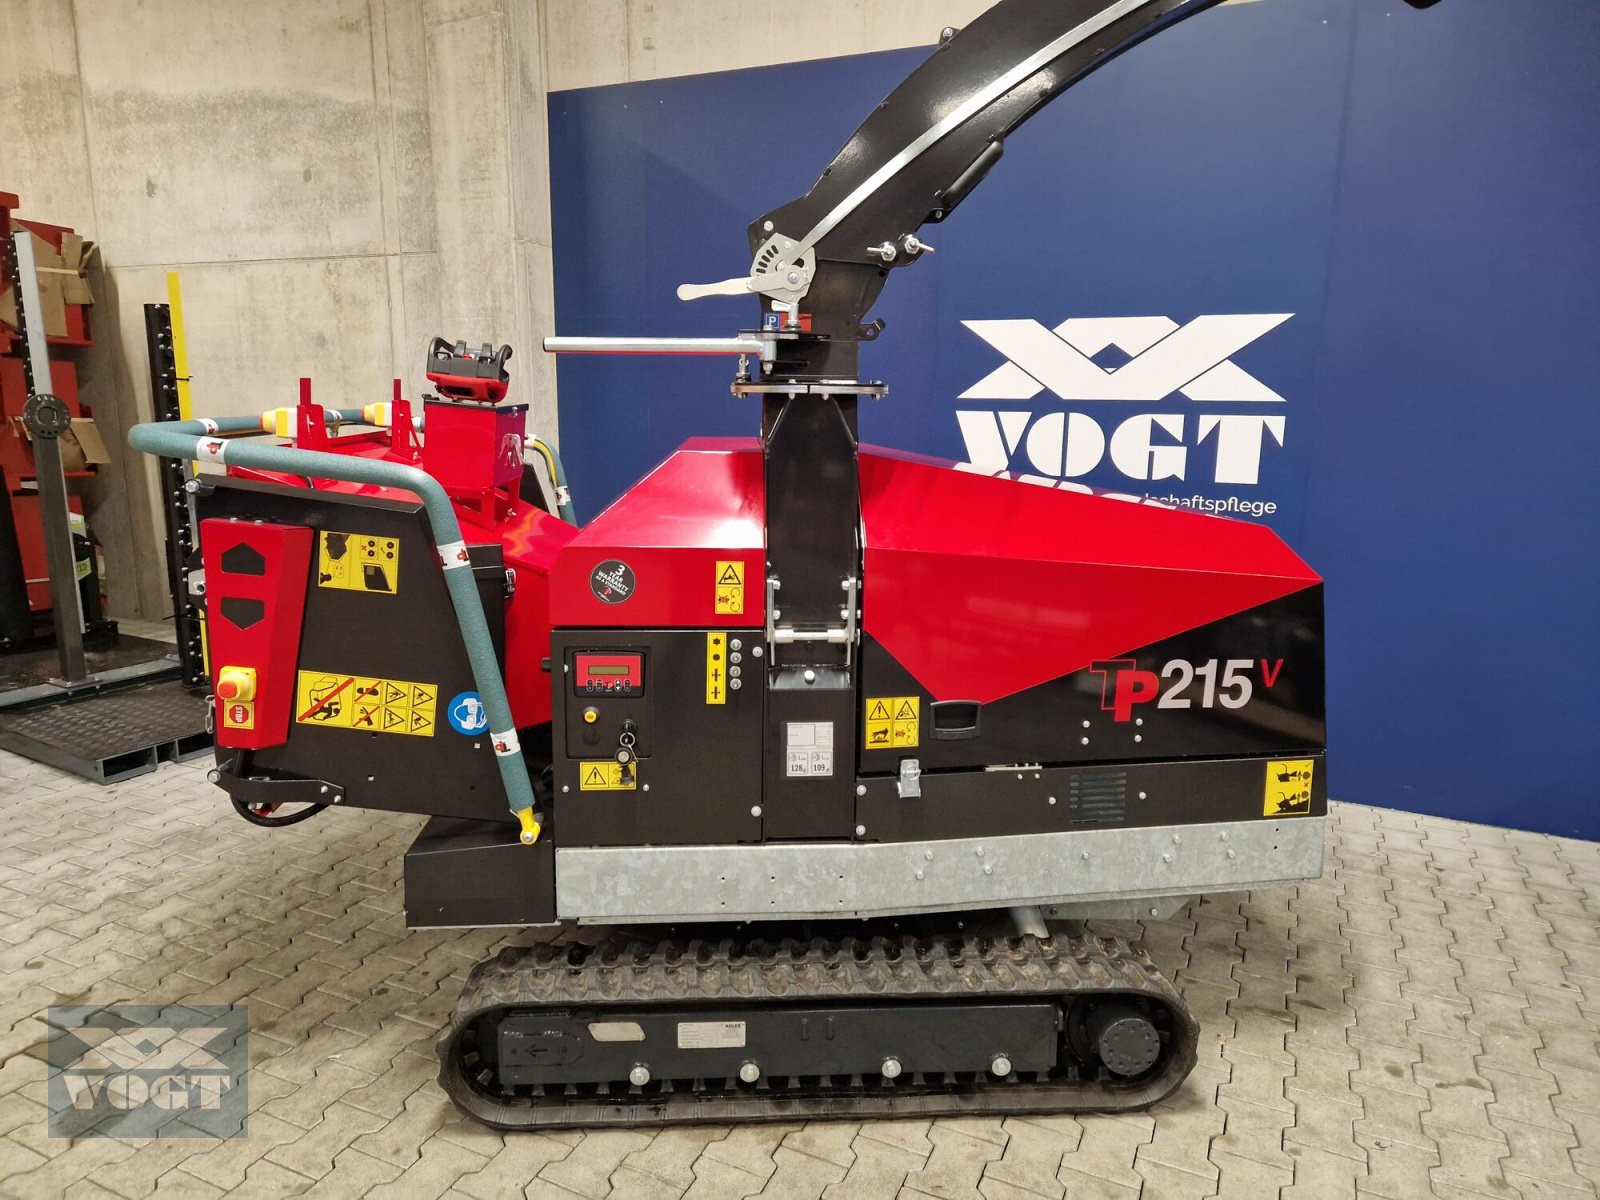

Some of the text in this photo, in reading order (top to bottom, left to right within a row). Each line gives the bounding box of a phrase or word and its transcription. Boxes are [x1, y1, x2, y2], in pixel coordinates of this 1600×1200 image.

[769, 316, 777, 326] P
[956, 410, 1286, 484] VOGT
[615, 564, 626, 576] 3
[598, 570, 629, 592] WARRANTY
[609, 571, 624, 584] YEAR
[1089, 658, 1284, 722] TP 215 V
[235, 705, 243, 723] STOP
[791, 764, 803, 772] 128
[814, 763, 826, 772] 109
